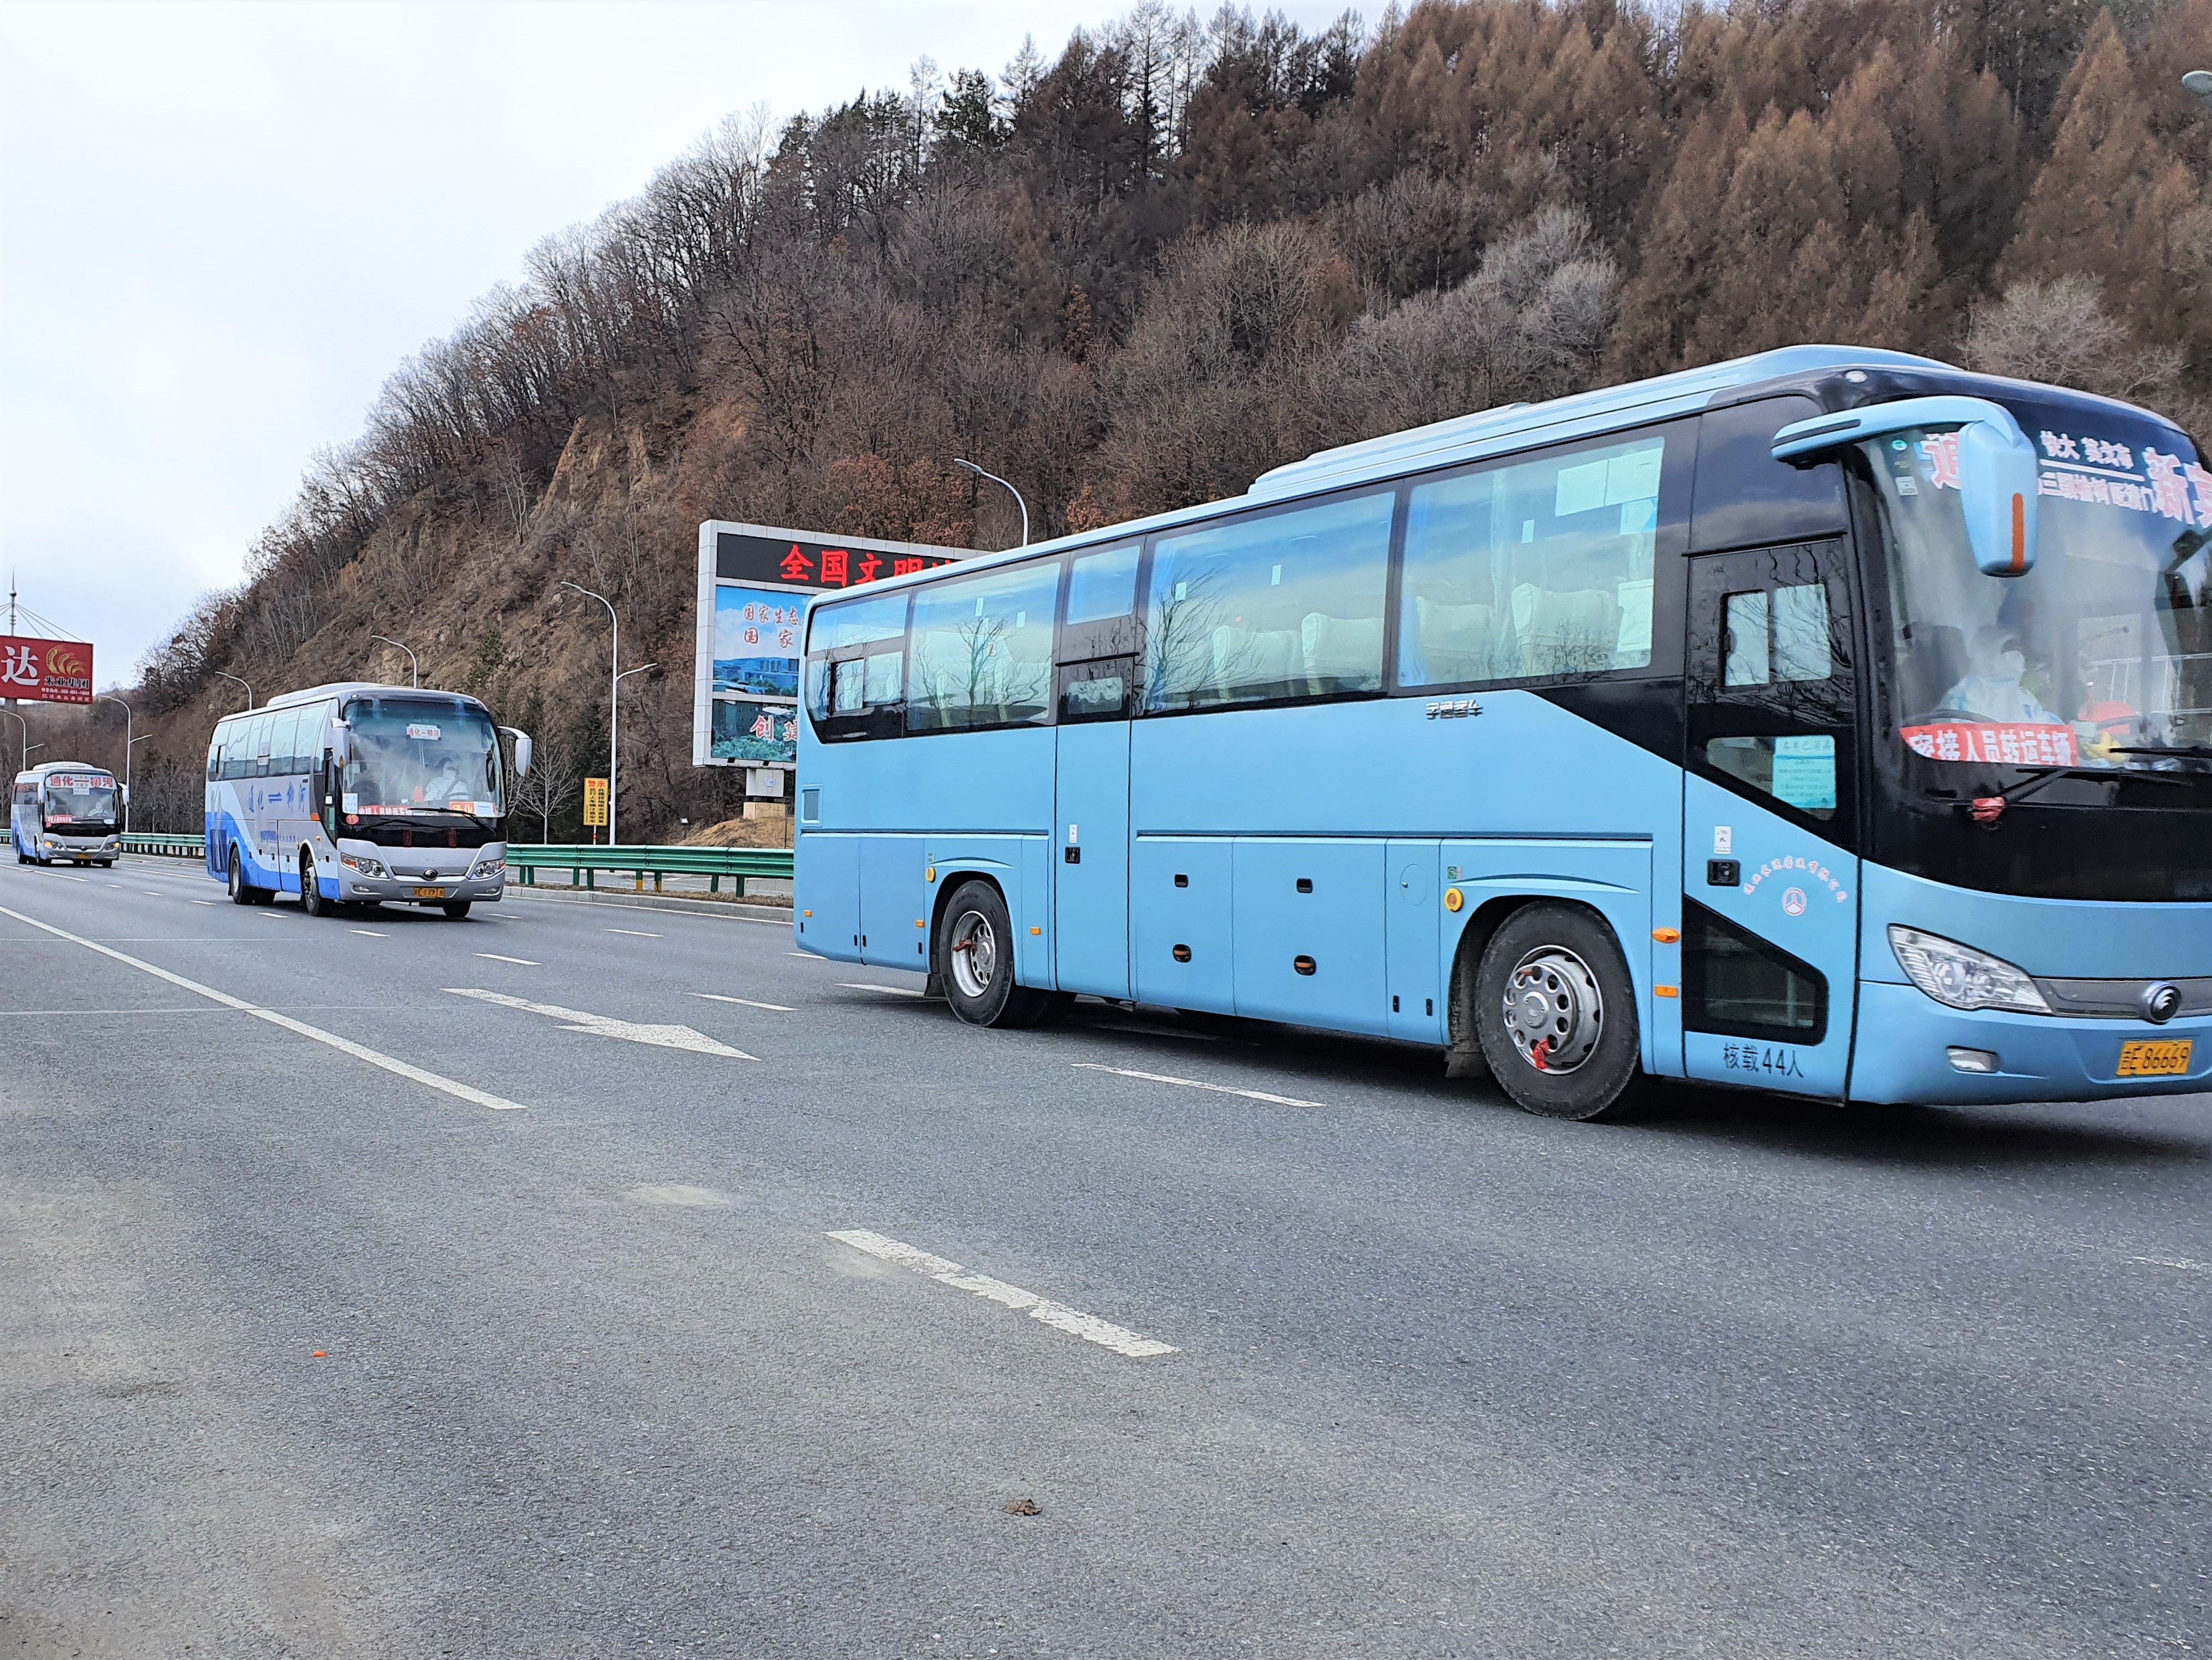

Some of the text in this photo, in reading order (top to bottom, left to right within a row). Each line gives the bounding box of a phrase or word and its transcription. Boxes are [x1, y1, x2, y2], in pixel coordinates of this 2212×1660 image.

[779, 544, 952, 587] 全国文明
[744, 604, 804, 626] 国家生态
[1, 646, 41, 686] 达
[1723, 1042, 1804, 1079] 核载44人
